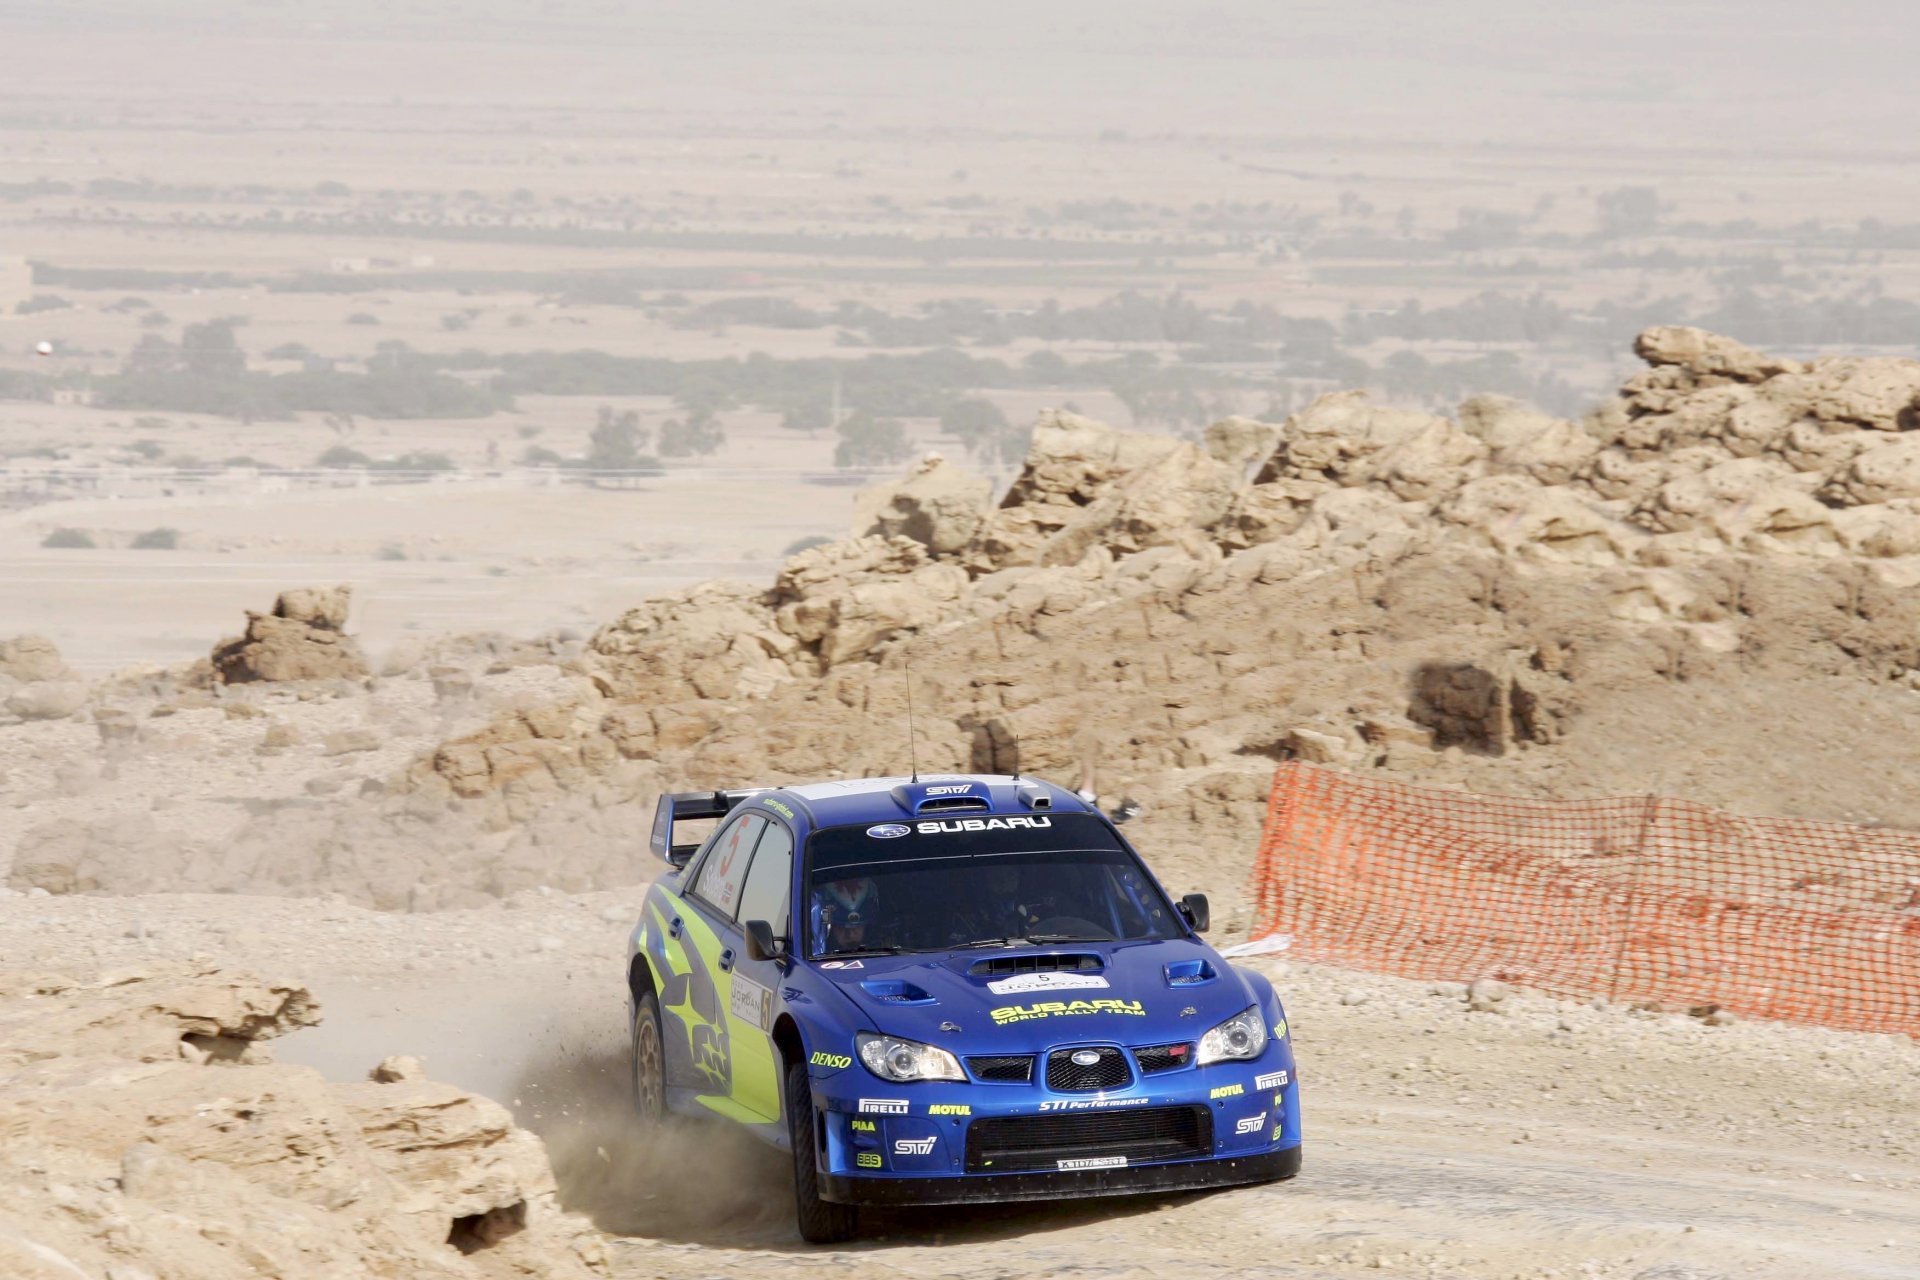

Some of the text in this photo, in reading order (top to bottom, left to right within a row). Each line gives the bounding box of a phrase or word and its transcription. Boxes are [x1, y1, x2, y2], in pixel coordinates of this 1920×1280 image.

[917, 816, 1052, 834] SUBARU
[719, 815, 751, 877] 5
[1000, 980, 1100, 991] JORDAN
[1038, 974, 1050, 982] 5
[732, 987, 760, 1011] JORDAN
[761, 990, 770, 1031] 5
[990, 999, 1143, 1020] SUBARU
[995, 1008, 1146, 1025] WORLD RALLY TEAM
[809, 1051, 852, 1069] DENSO
[1254, 1070, 1288, 1090] PIRELLI
[1210, 1083, 1244, 1099] MOTUL
[858, 1098, 910, 1114] PIRELLI
[928, 1104, 972, 1116] MOTUL
[1038, 1098, 1149, 1111] STI Performance
[852, 1120, 876, 1131] PIAA
[858, 1154, 880, 1167] BBS
